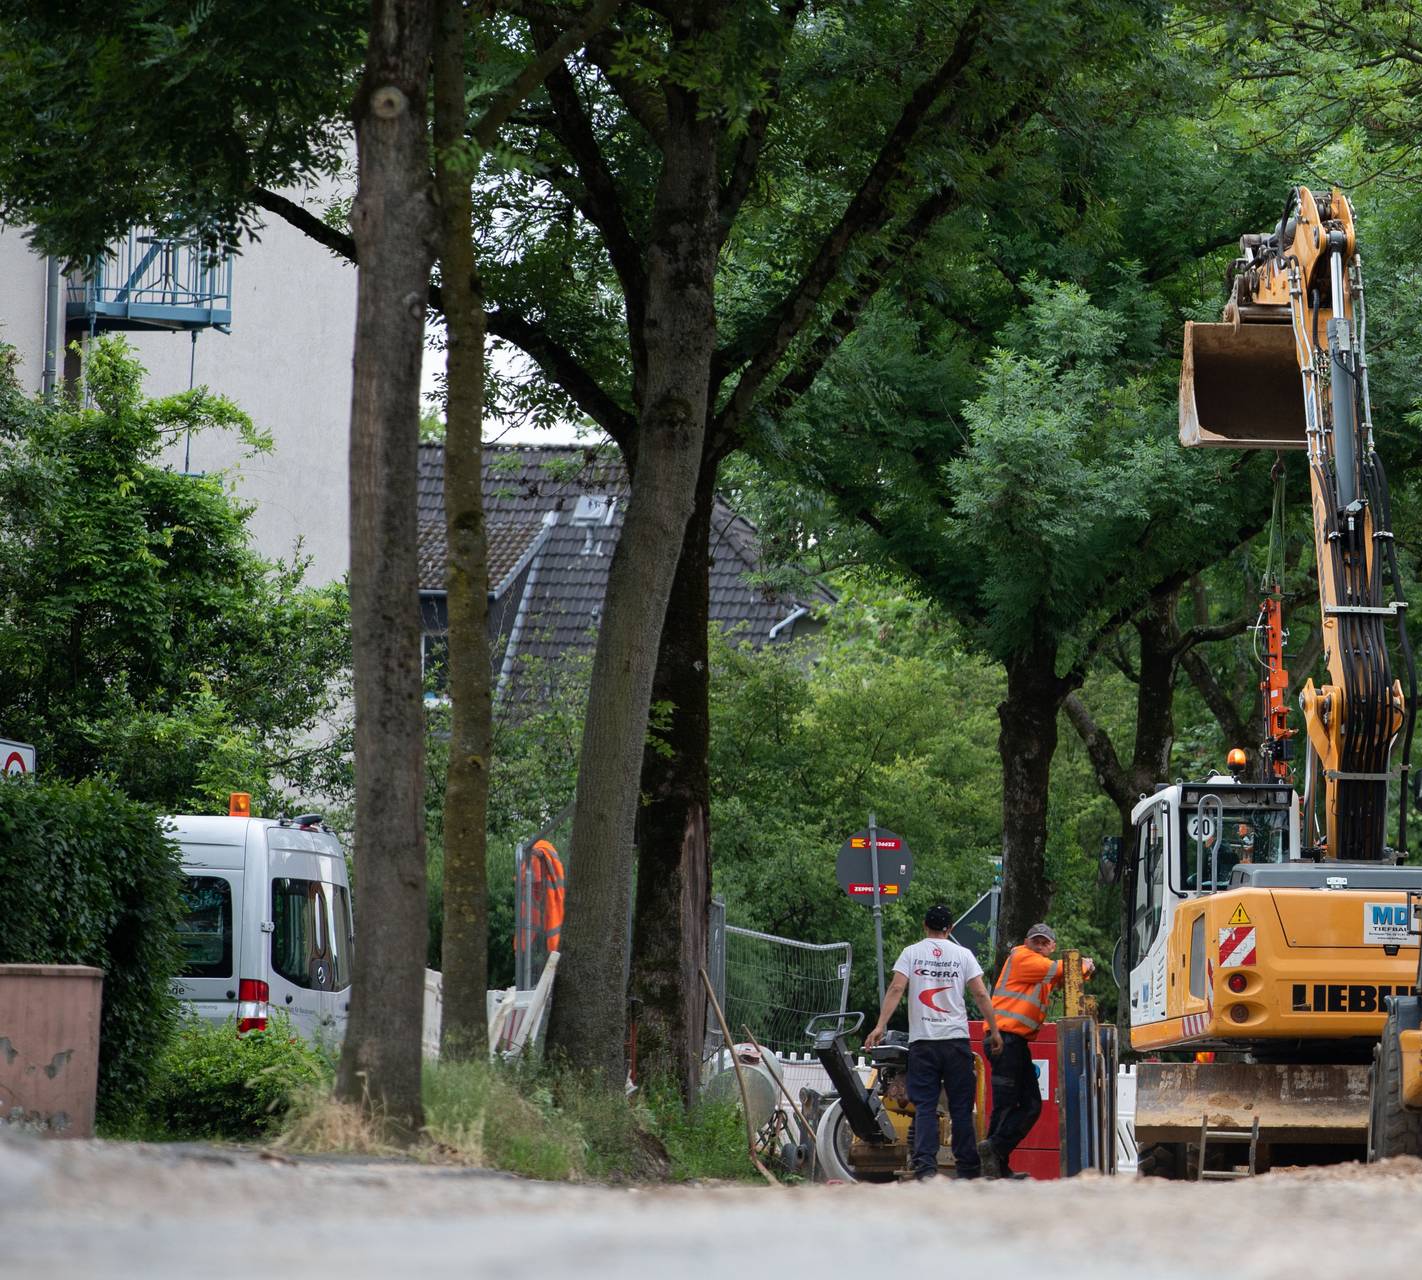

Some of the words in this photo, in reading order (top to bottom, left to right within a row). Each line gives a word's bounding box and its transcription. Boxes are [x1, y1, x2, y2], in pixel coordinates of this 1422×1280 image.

[1193, 819, 1210, 836] 20
[920, 969, 959, 978] COFRA
[1292, 984, 1418, 1012] LIEBH
